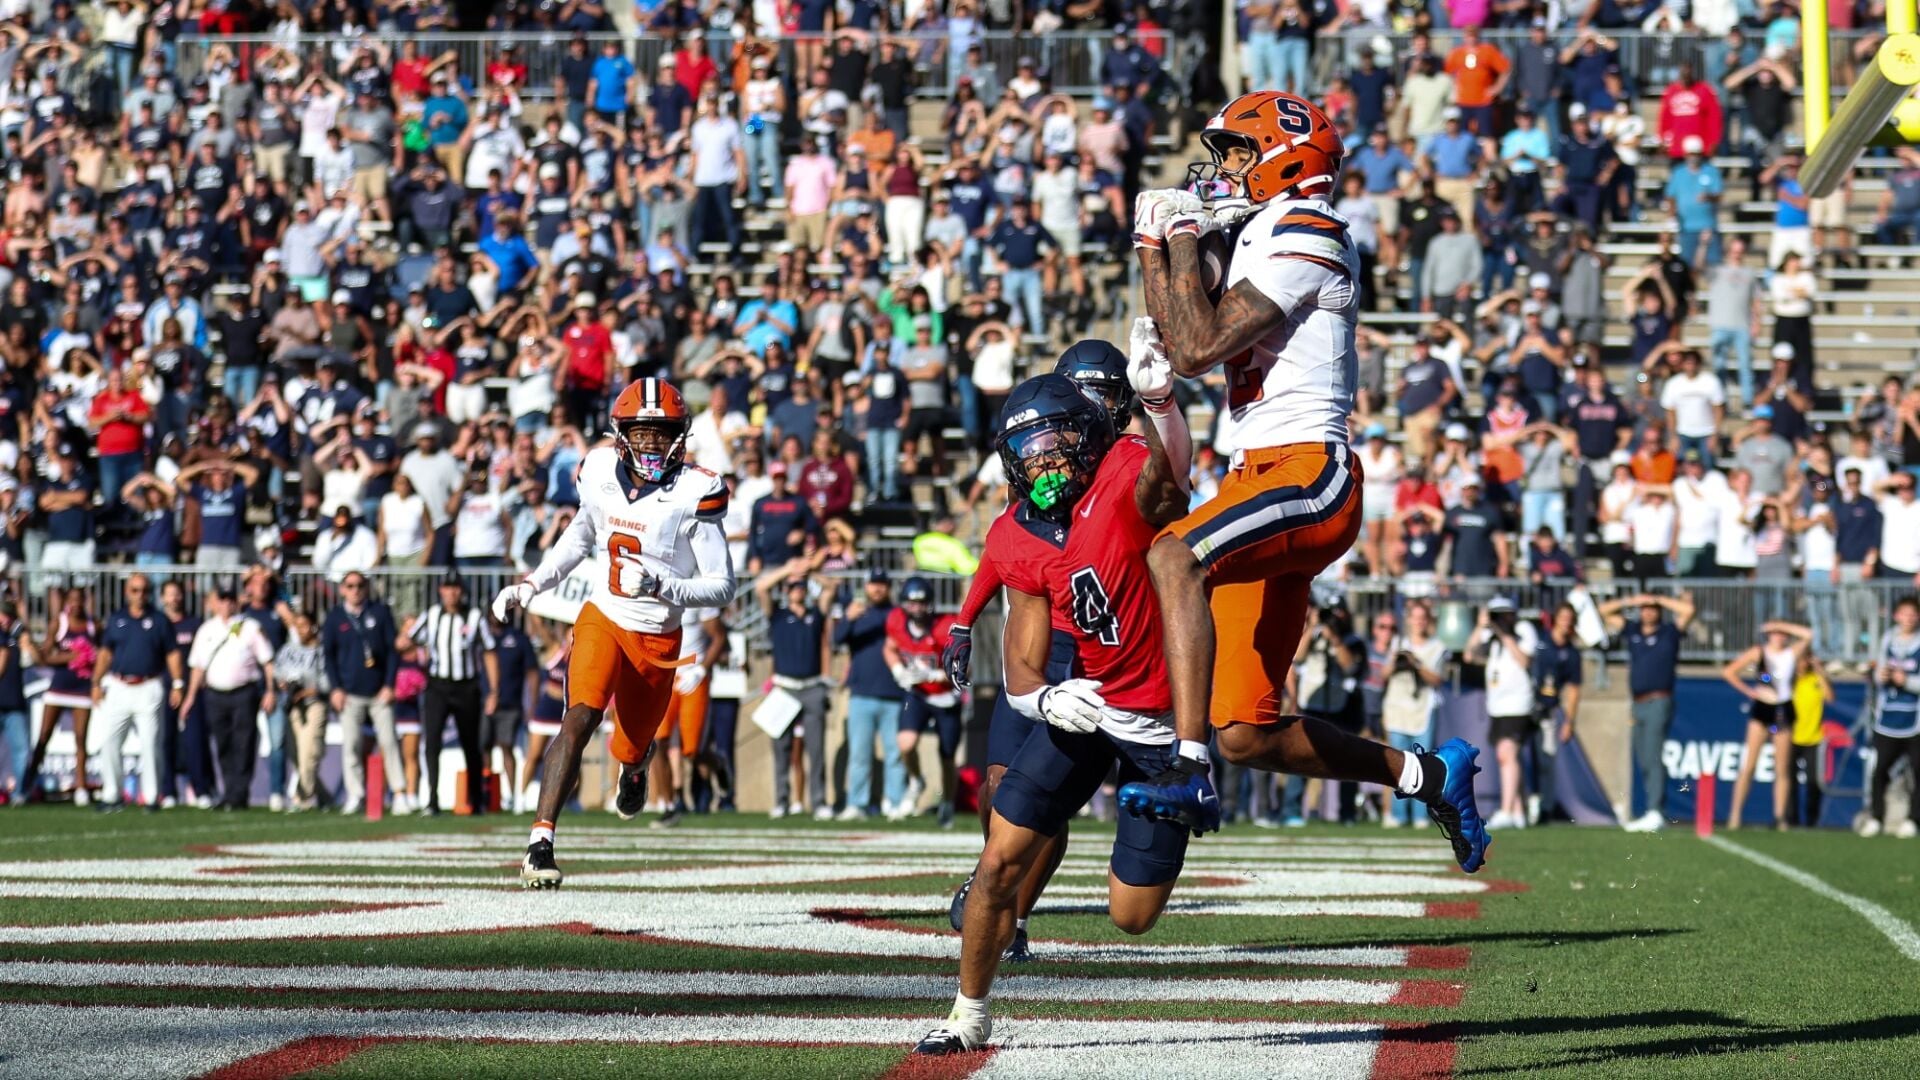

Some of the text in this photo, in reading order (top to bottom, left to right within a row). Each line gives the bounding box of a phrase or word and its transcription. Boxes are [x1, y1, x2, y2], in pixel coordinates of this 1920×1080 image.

[1275, 97, 1313, 135] S
[607, 515, 648, 533] ORANGE
[608, 531, 642, 599] 6
[1069, 564, 1121, 647] 4
